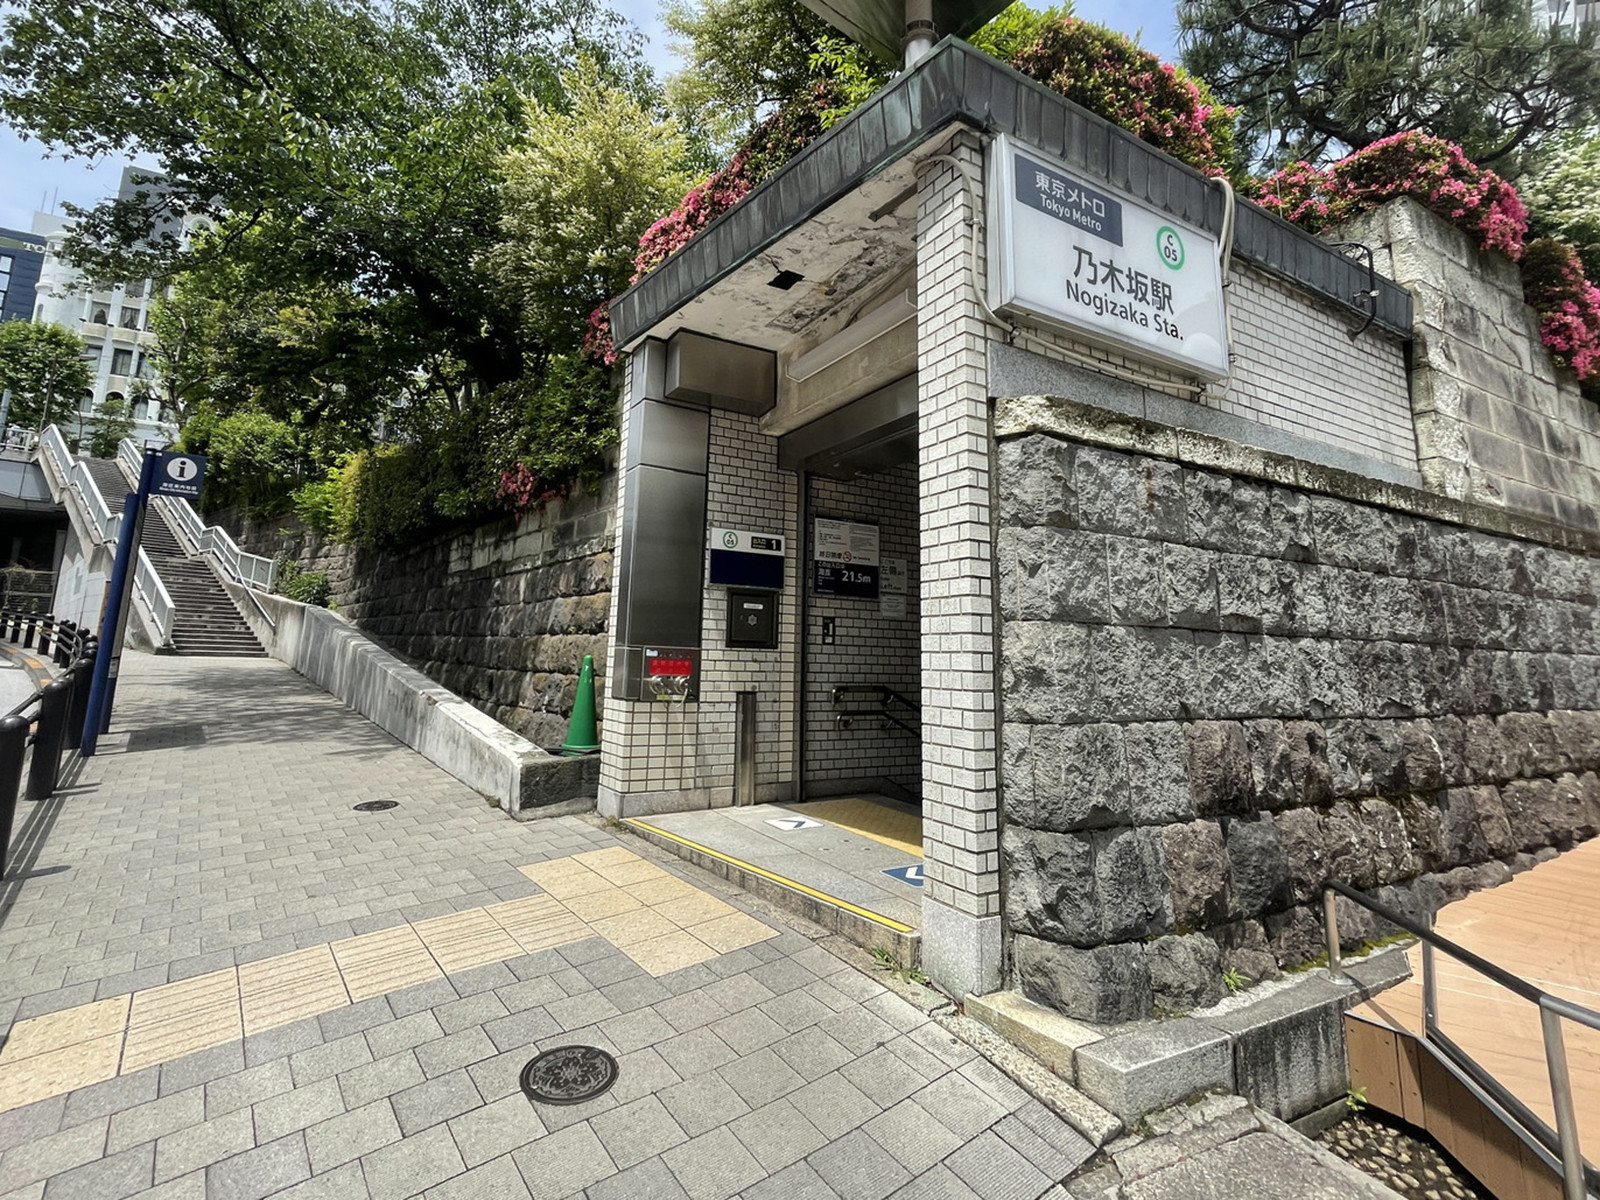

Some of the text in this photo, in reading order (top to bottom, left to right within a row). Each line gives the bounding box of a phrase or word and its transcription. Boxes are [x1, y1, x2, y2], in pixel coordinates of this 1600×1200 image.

[1035, 171, 1105, 218] 東京メトロ
[1040, 194, 1102, 231] Tokyo Metro
[1166, 234, 1174, 246] C
[1164, 246, 1178, 262] 05
[1072, 245, 1175, 315] 乃木坂駅
[1066, 279, 1184, 341] Nogizaka Sta.
[771, 540, 777, 550] 1
[842, 570, 871, 583] 21.5m
